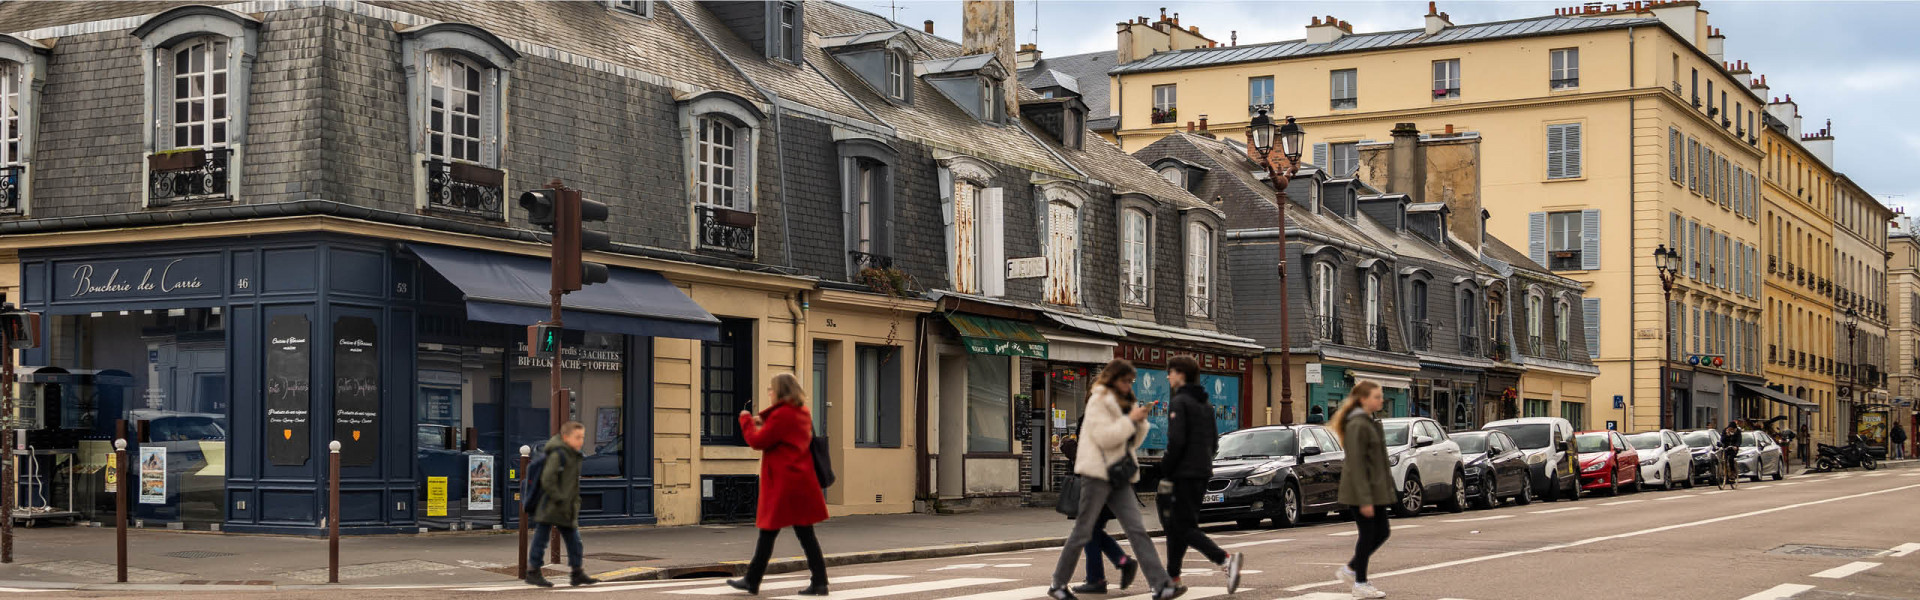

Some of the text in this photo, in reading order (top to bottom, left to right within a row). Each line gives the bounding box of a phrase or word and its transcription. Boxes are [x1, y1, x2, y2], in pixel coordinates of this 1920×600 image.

[71, 258, 203, 297] Boucherie des Carrés
[237, 278, 248, 288] 46
[397, 282, 407, 293] 53
[561, 346, 577, 355] redis
[1124, 345, 1247, 371] IMPRERIE
[561, 358, 581, 370] ACHÉ
[593, 361, 619, 371] OFFERT
